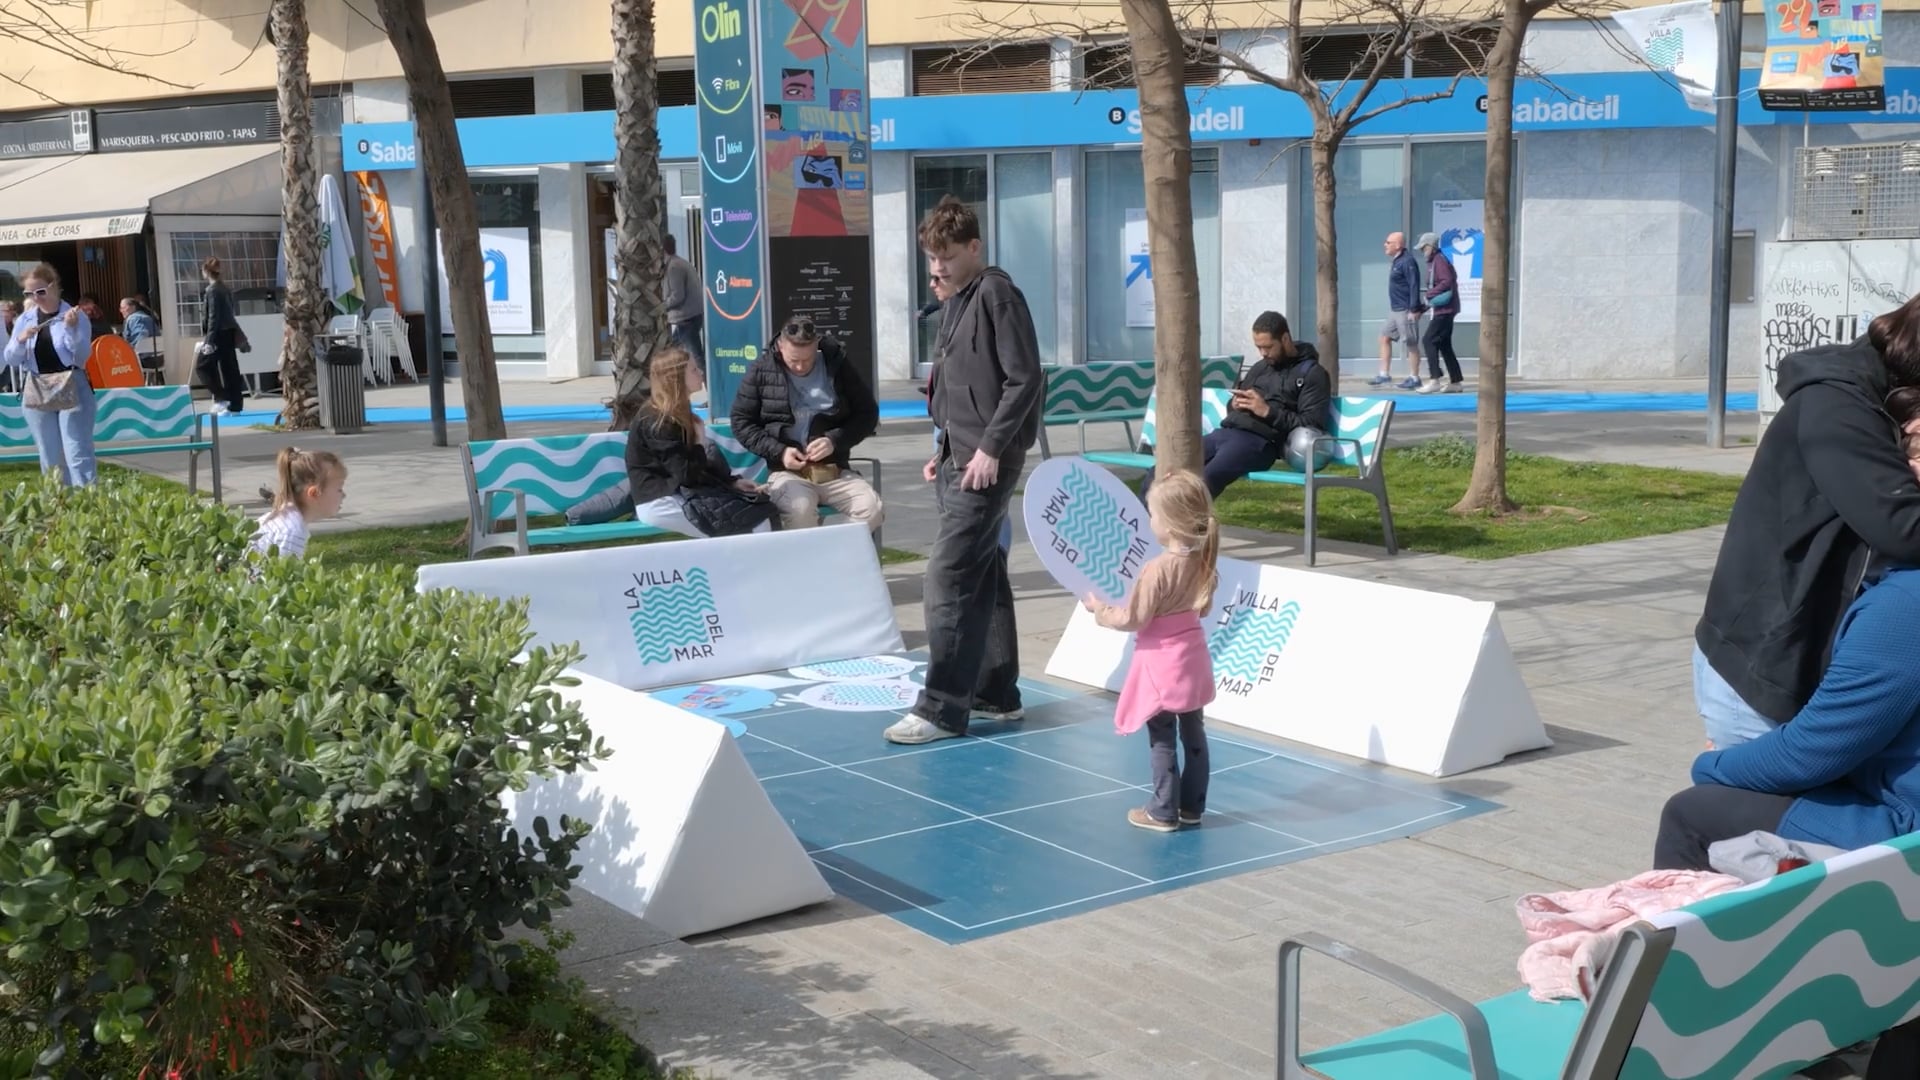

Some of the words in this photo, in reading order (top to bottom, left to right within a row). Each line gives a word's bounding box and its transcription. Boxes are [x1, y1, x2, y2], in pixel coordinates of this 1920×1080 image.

[702, 1, 741, 43] Olin
[1650, 29, 1671, 37] VILLA
[1645, 37, 1651, 49] LA
[1512, 95, 1620, 123] abadell
[870, 119, 895, 142] ell
[1127, 106, 1244, 135] Sdell
[3, 144, 26, 154] COCINA
[101, 135, 155, 148] MARISQUERIA
[161, 132, 199, 144] PESCADO
[200, 130, 224, 141] FRITO
[232, 128, 257, 139] TAPAS
[371, 141, 415, 163] Saba
[0, 230, 18, 241] NEA
[26, 225, 47, 239] CAFÉ
[52, 224, 80, 237] COPAS
[1041, 487, 1070, 526] MAR
[1119, 507, 1139, 532] LA
[1051, 531, 1079, 564] DEL
[1118, 537, 1149, 579] VILLA
[632, 569, 683, 586] VILLA
[624, 587, 640, 609] LA
[1240, 590, 1279, 612] VILLA
[1217, 604, 1235, 626] LA
[706, 614, 724, 643] DEL
[674, 644, 714, 661] MAR
[1258, 653, 1279, 685] DEL
[1217, 676, 1254, 697] MAR
